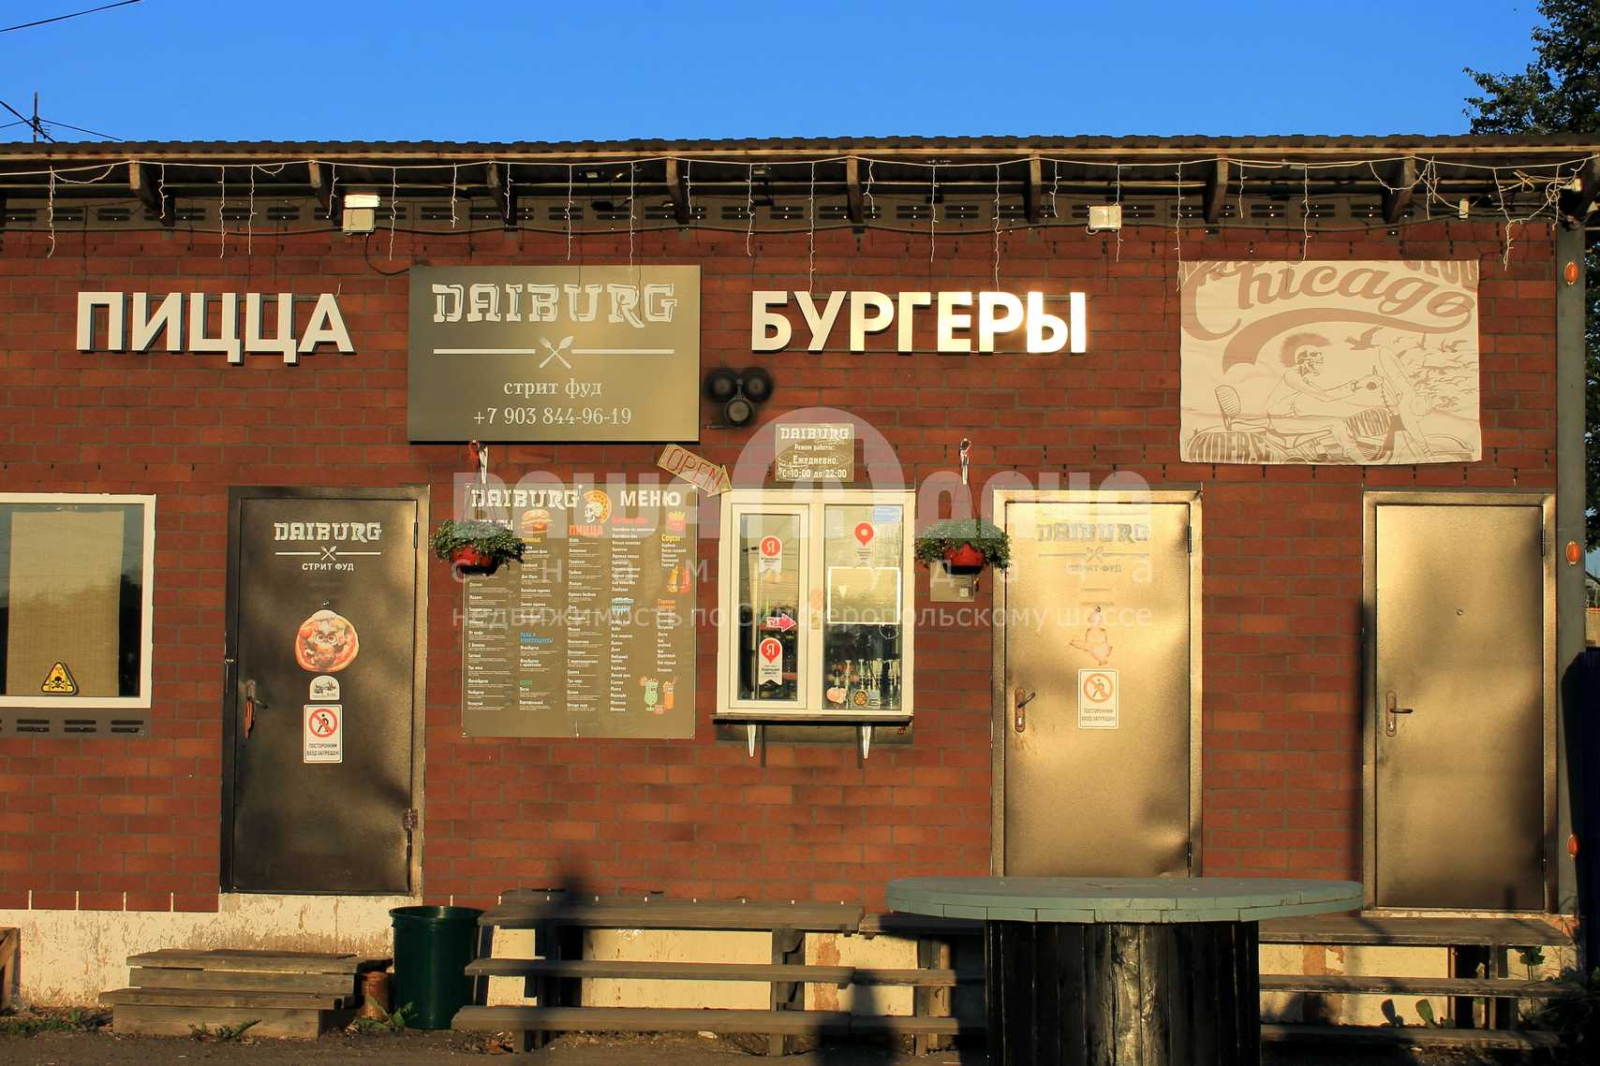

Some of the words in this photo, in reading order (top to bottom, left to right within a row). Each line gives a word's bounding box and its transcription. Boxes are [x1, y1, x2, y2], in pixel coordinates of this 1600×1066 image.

[431, 283, 677, 328] DAIBURG
[1181, 261, 1475, 341] Chicago
[76, 291, 354, 364] ПИЦЦА
[751, 291, 1086, 353] БУРГЕРЫ
[503, 380, 559, 399] стрит
[564, 378, 603, 400] фуд
[473, 407, 498, 426] +7
[503, 407, 537, 426] 903
[541, 407, 632, 426] 844-96-19
[780, 427, 850, 441] DAIBURG
[667, 448, 724, 494] OPEN
[790, 468, 811, 479] 10:00
[825, 468, 848, 479] 22:00
[471, 489, 578, 510] DAIBURG
[619, 490, 681, 508] МЕНЮ
[274, 522, 382, 543] DAIBURG
[1037, 523, 1149, 544] DAIBURG
[302, 563, 332, 571] СТРИТ
[334, 563, 355, 571] ФУД
[766, 642, 775, 656] Я
